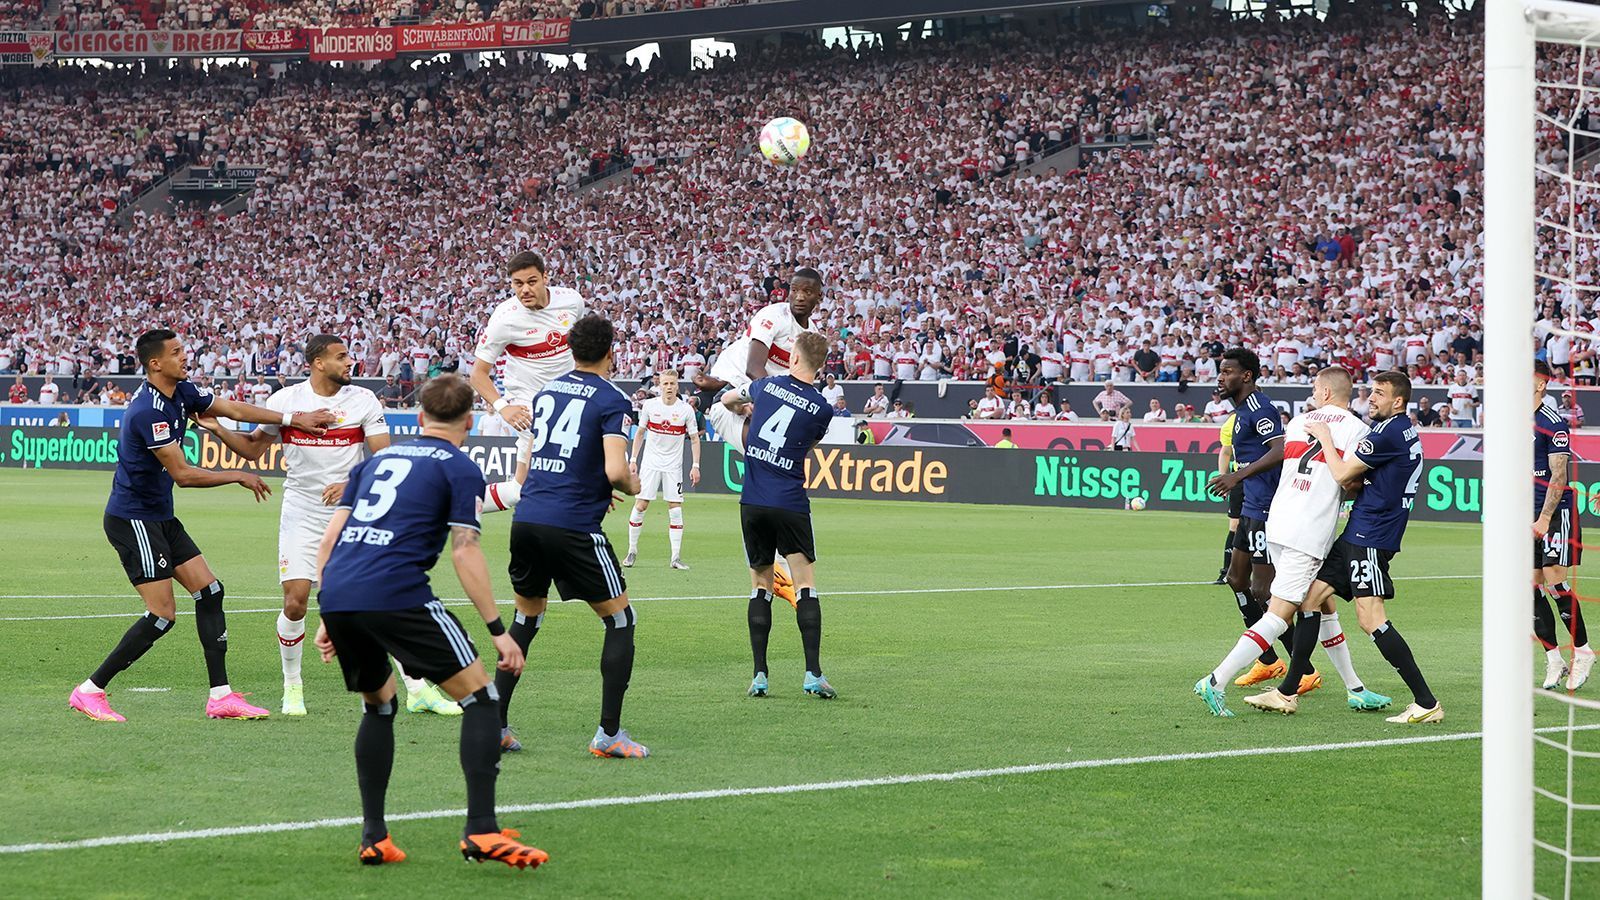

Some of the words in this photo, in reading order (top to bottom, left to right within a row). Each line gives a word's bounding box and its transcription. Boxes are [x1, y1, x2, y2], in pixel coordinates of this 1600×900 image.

[58, 33, 148, 53] GIENGEN
[173, 33, 240, 52] BRENZ
[403, 24, 496, 46] SCHWABENFRONT
[581, 384, 598, 398] SV
[763, 381, 811, 409] HAMBURGER
[807, 401, 821, 416] SV
[531, 394, 587, 459] 34
[757, 403, 797, 453] 4
[11, 429, 119, 469] Superfoods
[431, 448, 454, 461] SV
[1297, 433, 1324, 476] 2
[352, 457, 413, 522] 3
[1034, 456, 1150, 501] Nüsse,
[1248, 530, 1267, 551] 18
[1542, 532, 1563, 554] 14
[1350, 559, 1373, 583] 23
